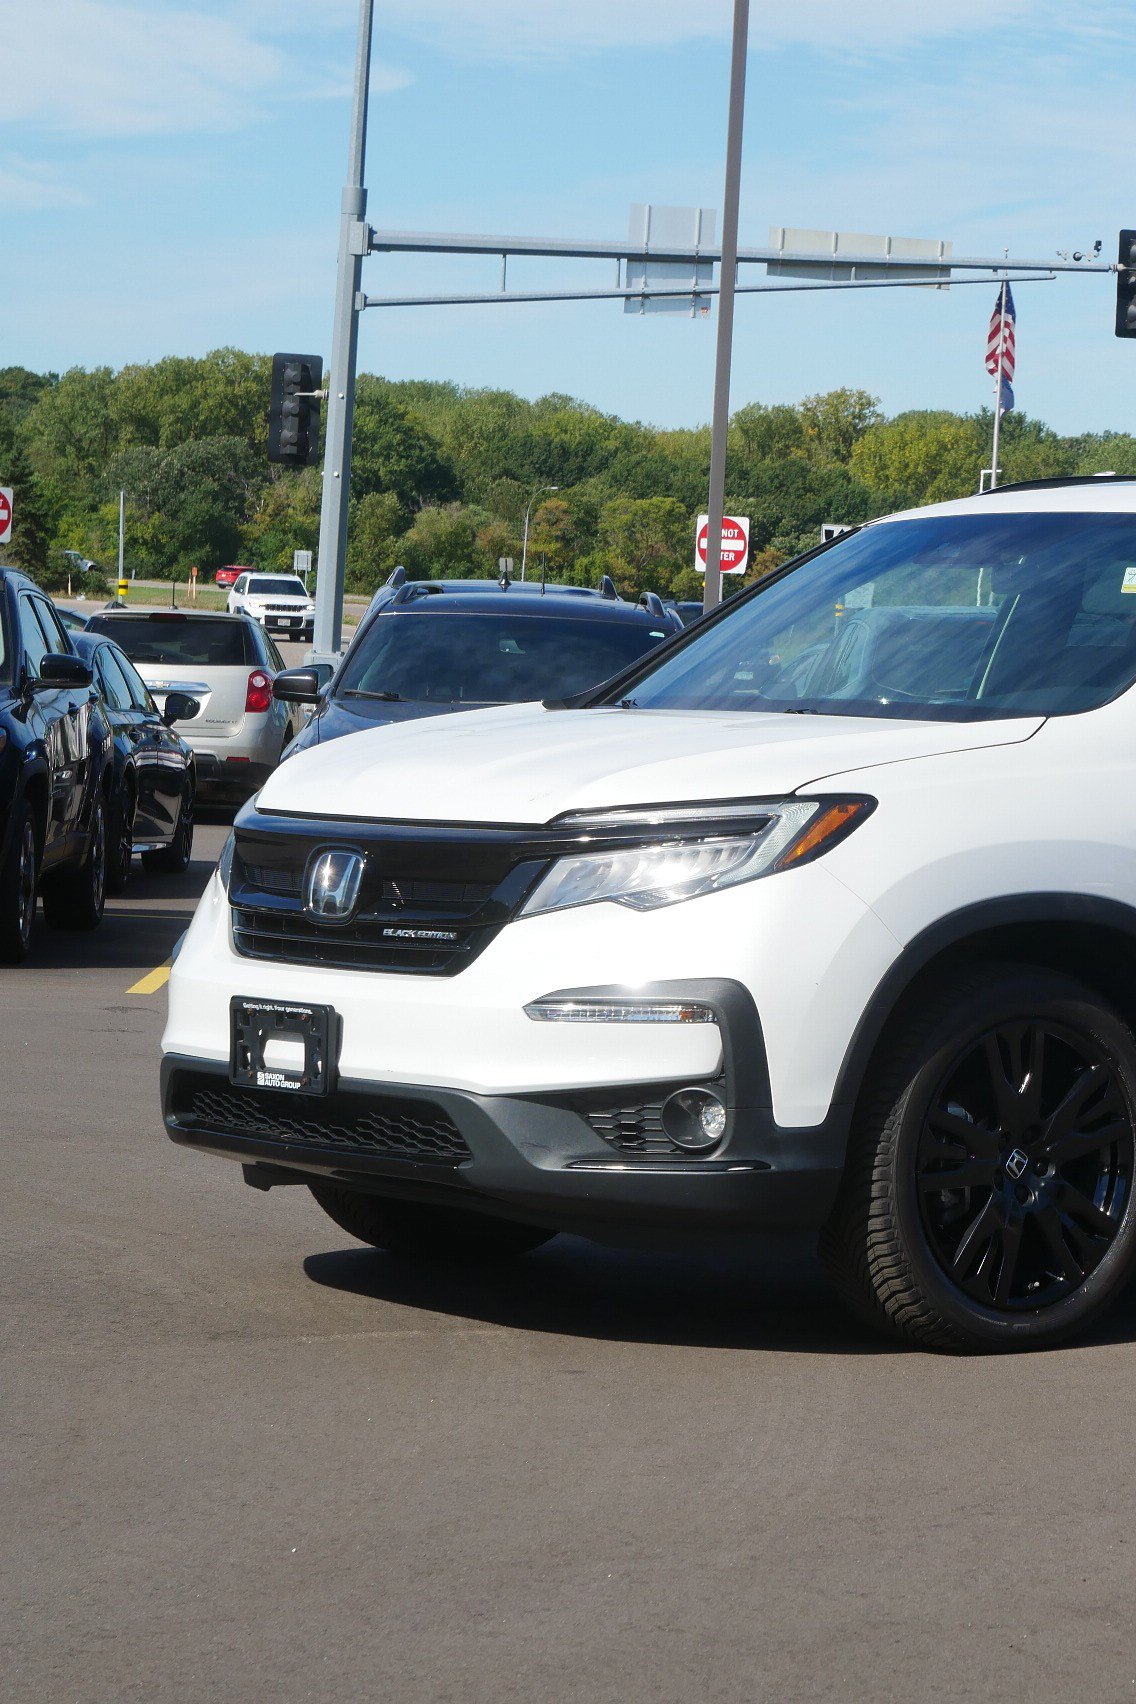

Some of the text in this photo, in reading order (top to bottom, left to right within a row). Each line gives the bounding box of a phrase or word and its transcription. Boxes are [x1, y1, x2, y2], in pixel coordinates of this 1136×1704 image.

[721, 528, 739, 538] NOT
[720, 551, 735, 561] TER
[383, 928, 416, 938] BLACK
[264, 1072, 285, 1081] SAXON
[280, 1081, 301, 1089] GROUP
